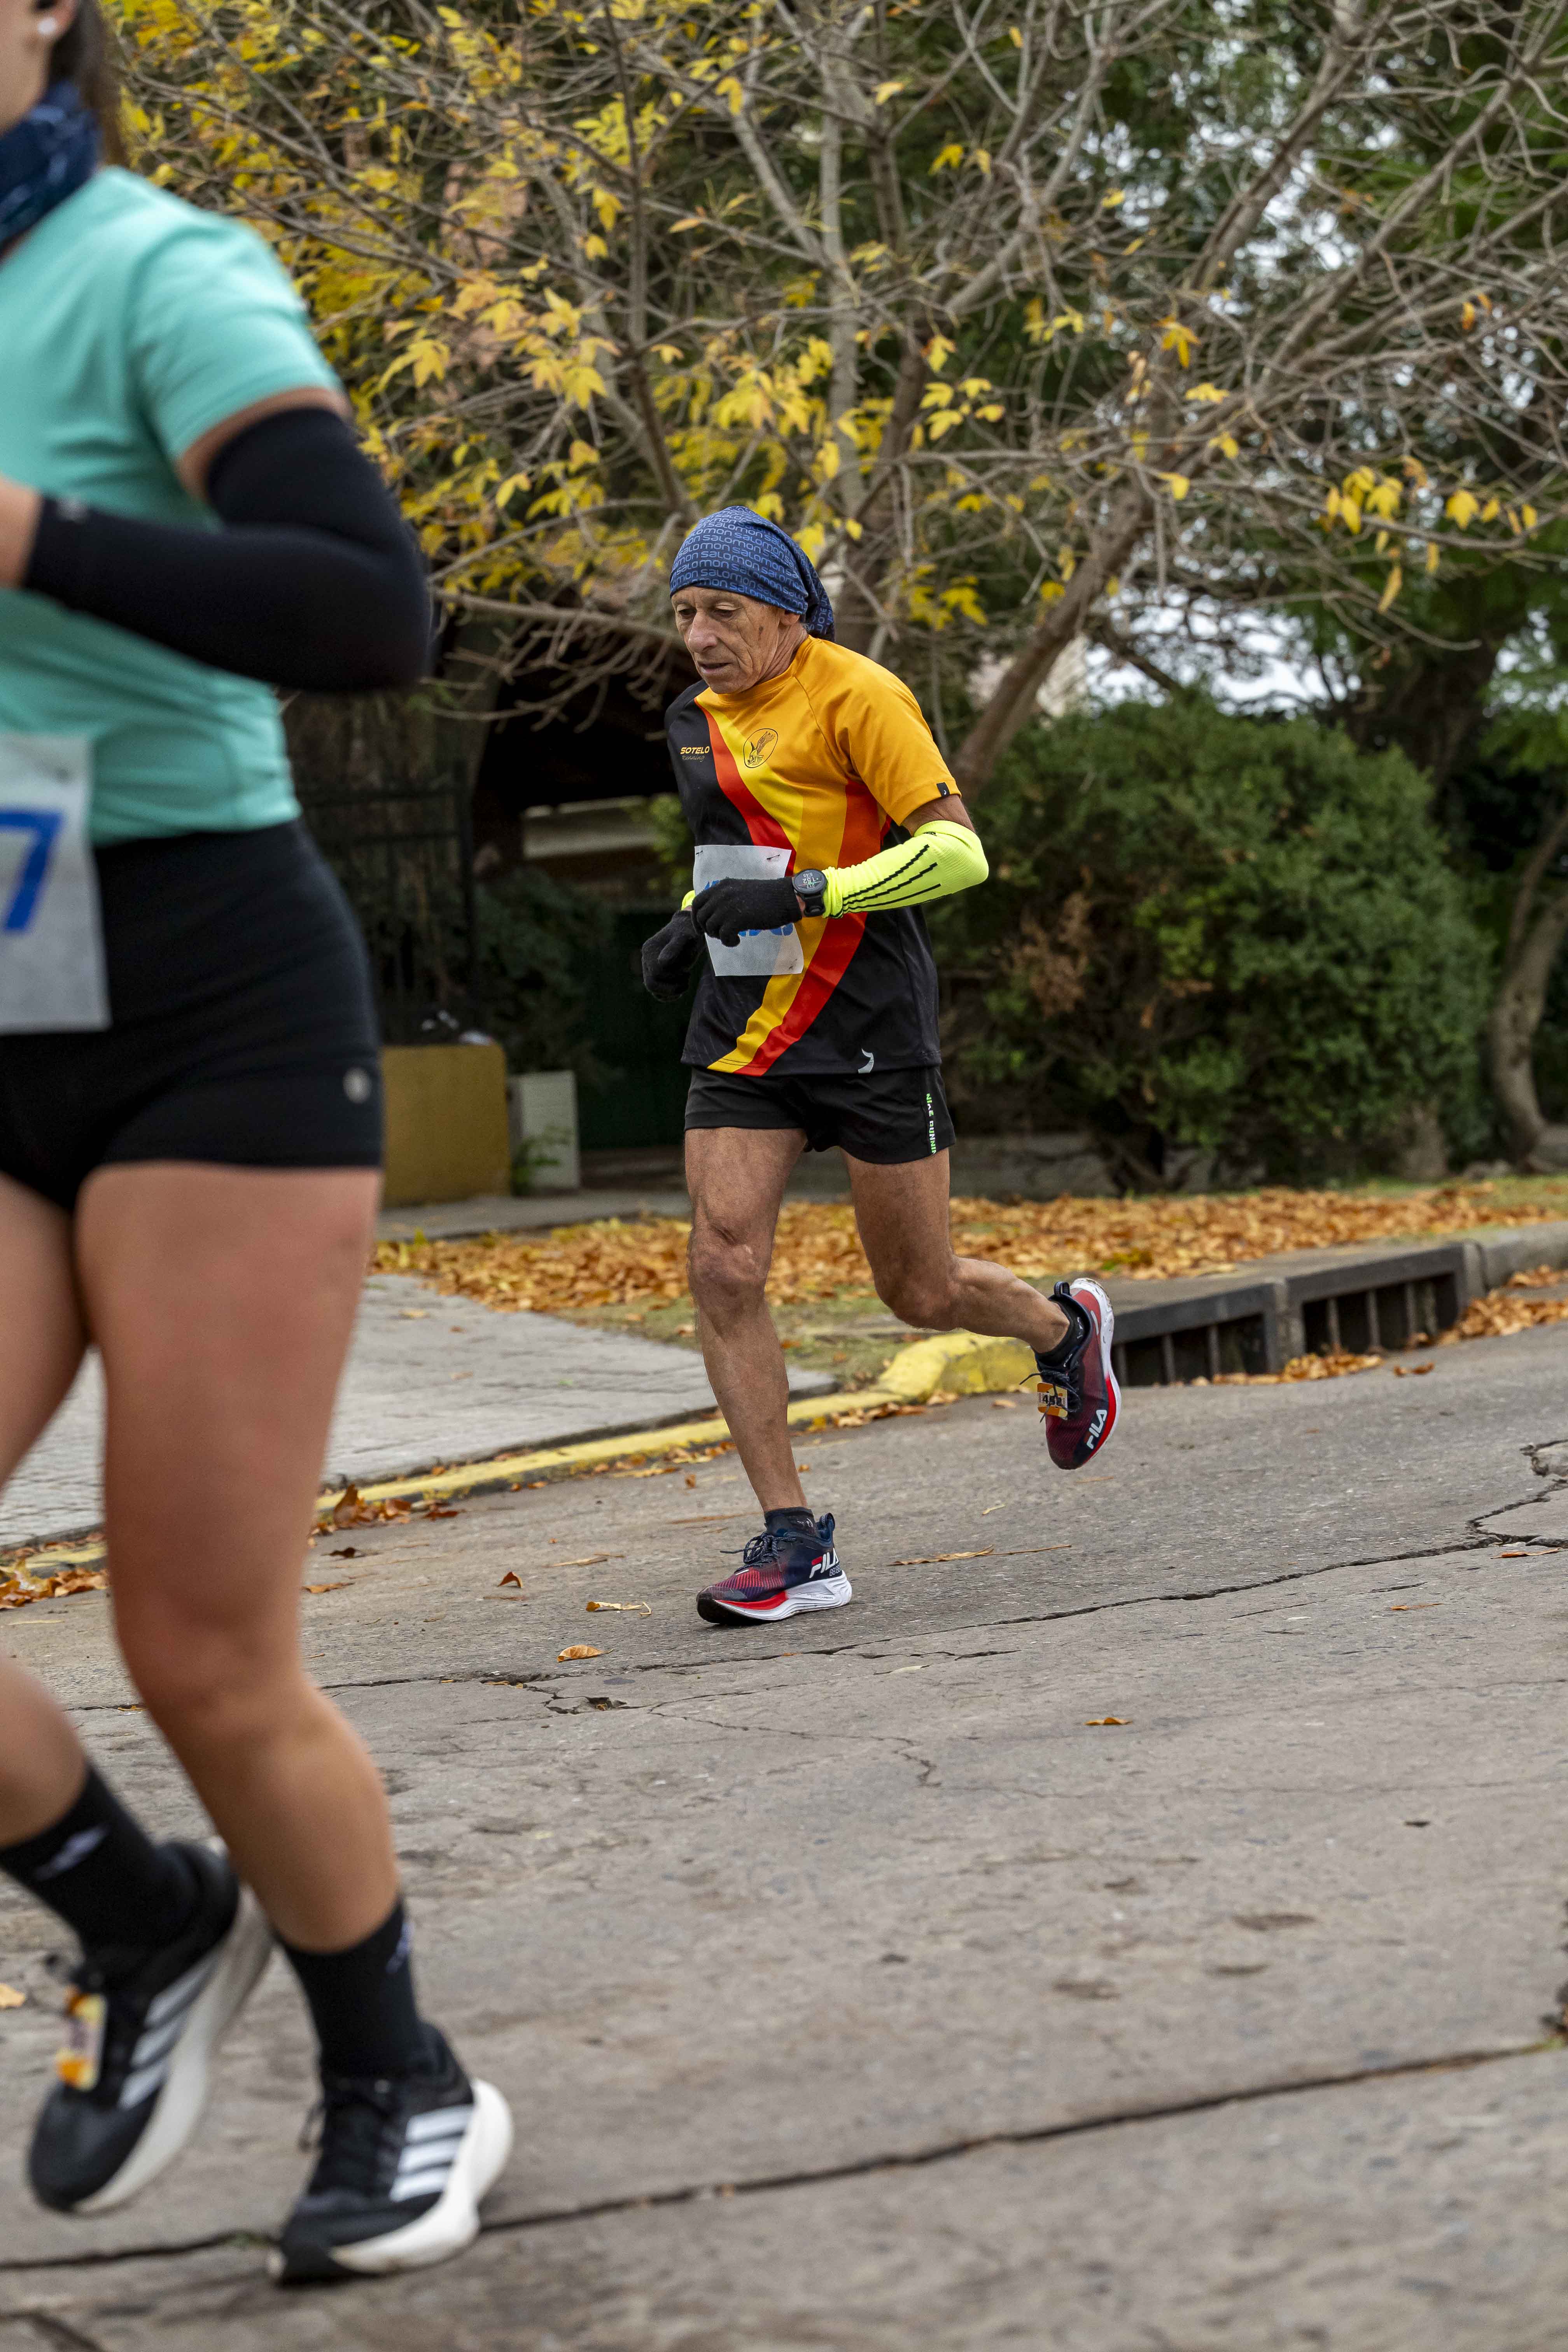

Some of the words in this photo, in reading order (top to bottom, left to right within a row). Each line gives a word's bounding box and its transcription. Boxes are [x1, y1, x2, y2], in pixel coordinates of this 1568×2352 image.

[680, 746, 710, 754] SOTELO
[1084, 1409, 1107, 1449] FILA
[809, 1547, 839, 1578] FILA
